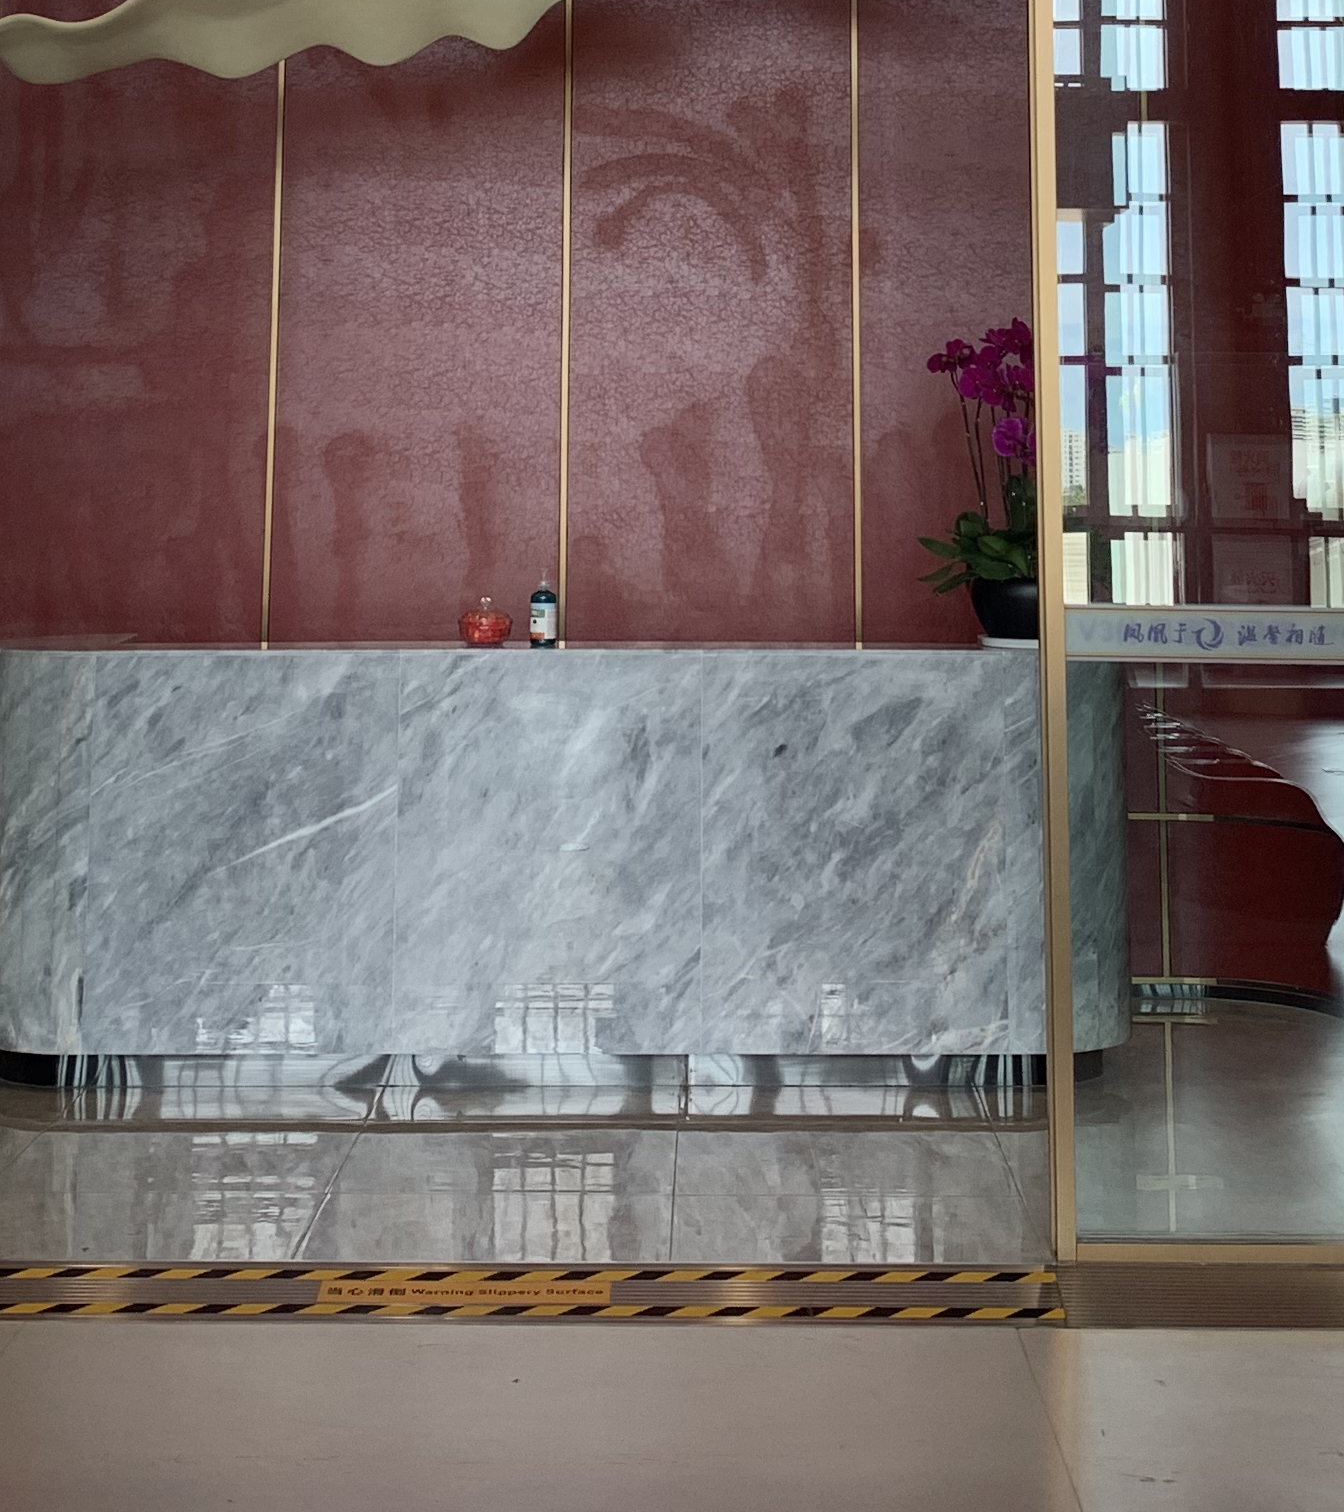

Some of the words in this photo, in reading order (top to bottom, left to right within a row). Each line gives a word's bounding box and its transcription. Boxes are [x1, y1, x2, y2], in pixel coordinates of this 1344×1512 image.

[327, 1286, 406, 1296] 当心滑倒
[411, 1288, 473, 1296] Warning
